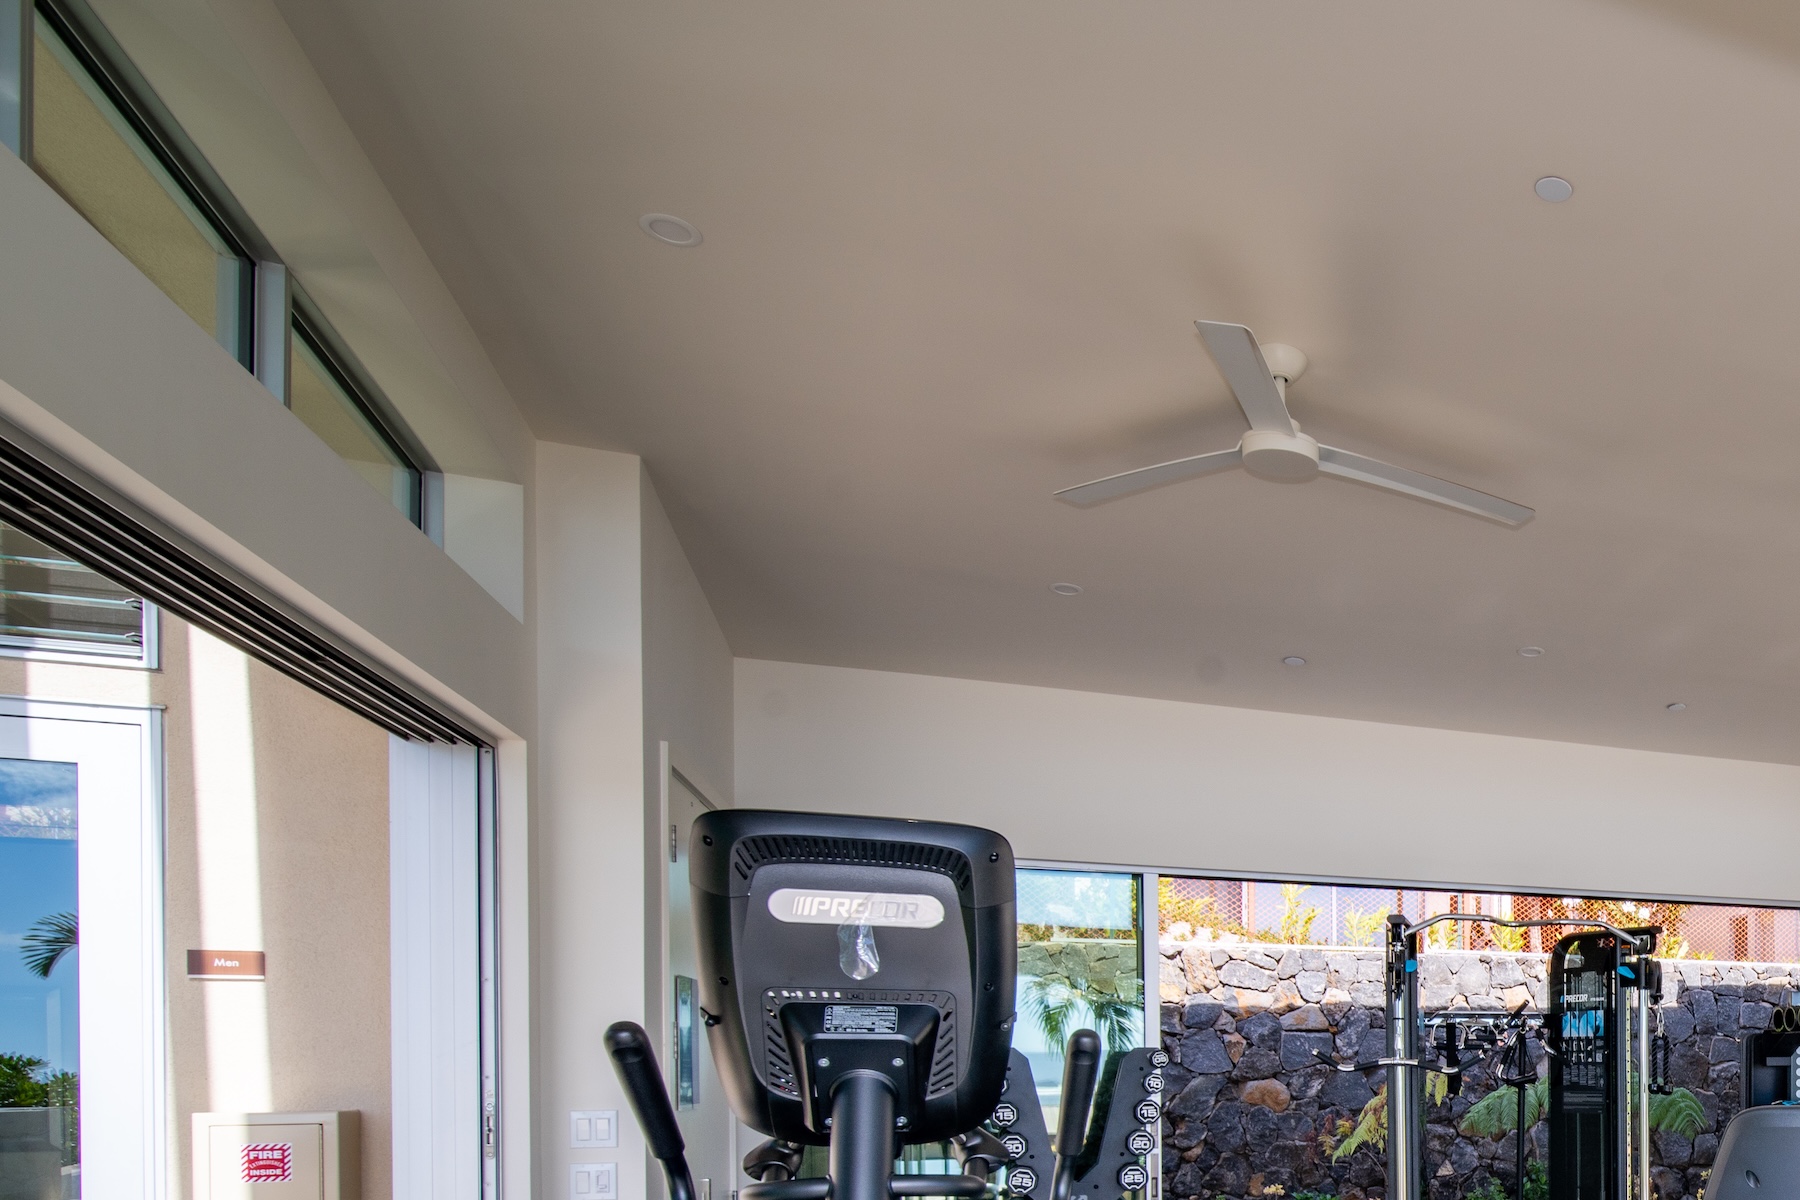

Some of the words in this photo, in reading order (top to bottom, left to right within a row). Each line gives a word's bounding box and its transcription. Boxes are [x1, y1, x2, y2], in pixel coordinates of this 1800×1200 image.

[810, 896, 919, 919] PRECOR
[213, 958, 240, 968] Men
[1564, 993, 1588, 1003] PRECOR
[1148, 1080, 1161, 1088] 10
[995, 1111, 1014, 1120] 15
[1141, 1109, 1157, 1118] 15
[1133, 1140, 1150, 1149] 20
[250, 1150, 283, 1160] FIRE
[250, 1168, 283, 1176] INSIDE
[1011, 1178, 1033, 1187] 25
[1124, 1174, 1143, 1183] 25
